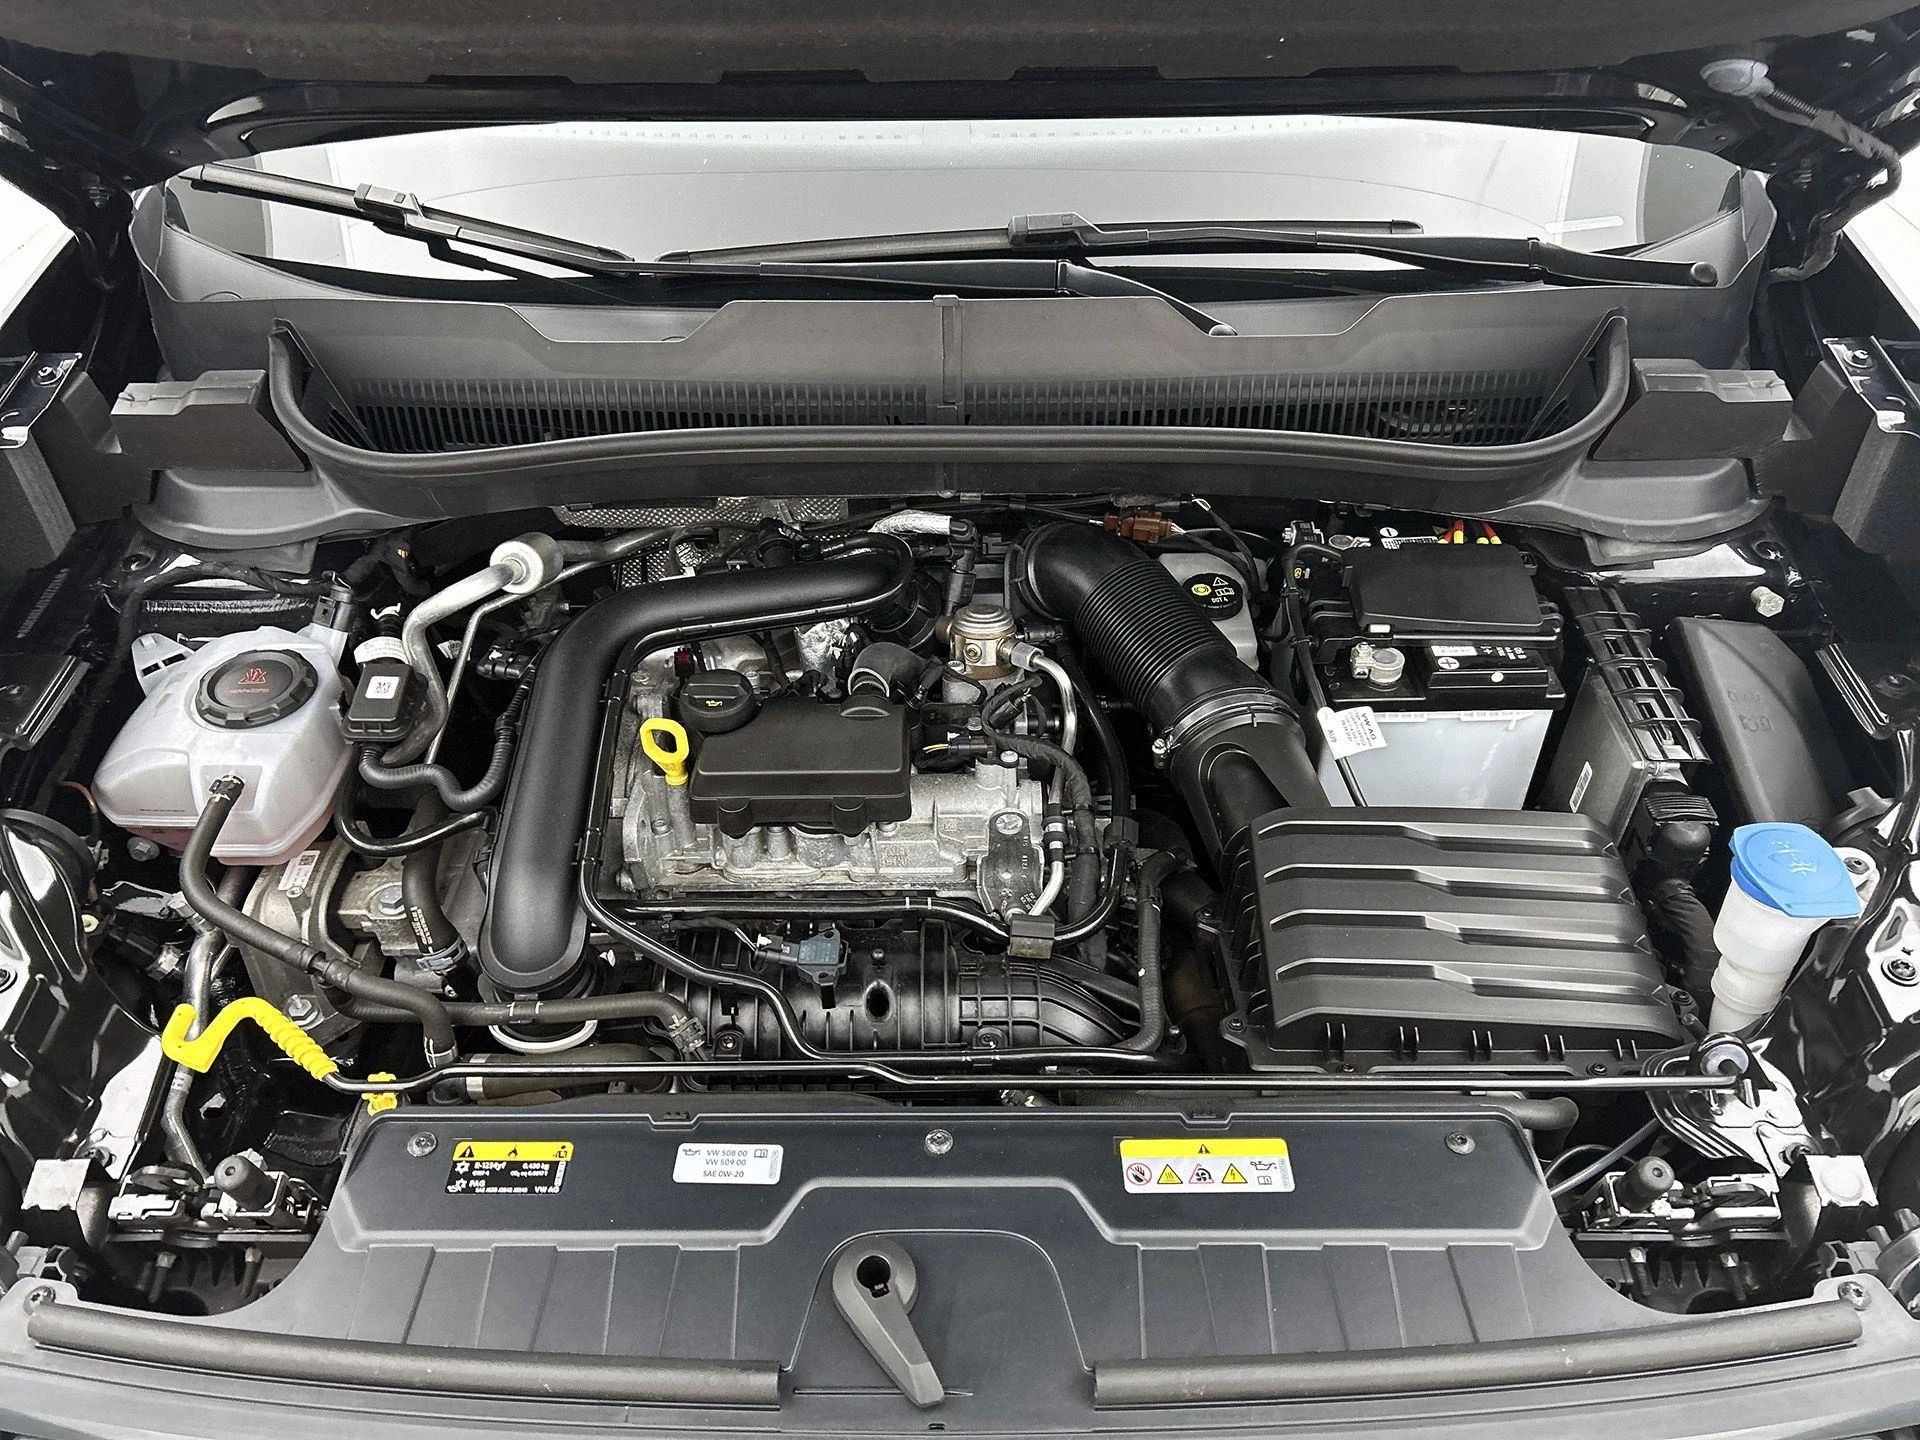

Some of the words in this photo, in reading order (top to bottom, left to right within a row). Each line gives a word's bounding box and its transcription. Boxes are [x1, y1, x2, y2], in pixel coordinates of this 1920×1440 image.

[1362, 712, 1371, 726] VW
[1368, 728, 1377, 740] AG
[721, 1149, 736, 1157] 508
[737, 1149, 748, 1157] 00
[720, 1158, 735, 1166] 509
[736, 1158, 747, 1166] 00
[718, 1170, 745, 1178] 0W-20
[469, 1179, 486, 1187] PAG
